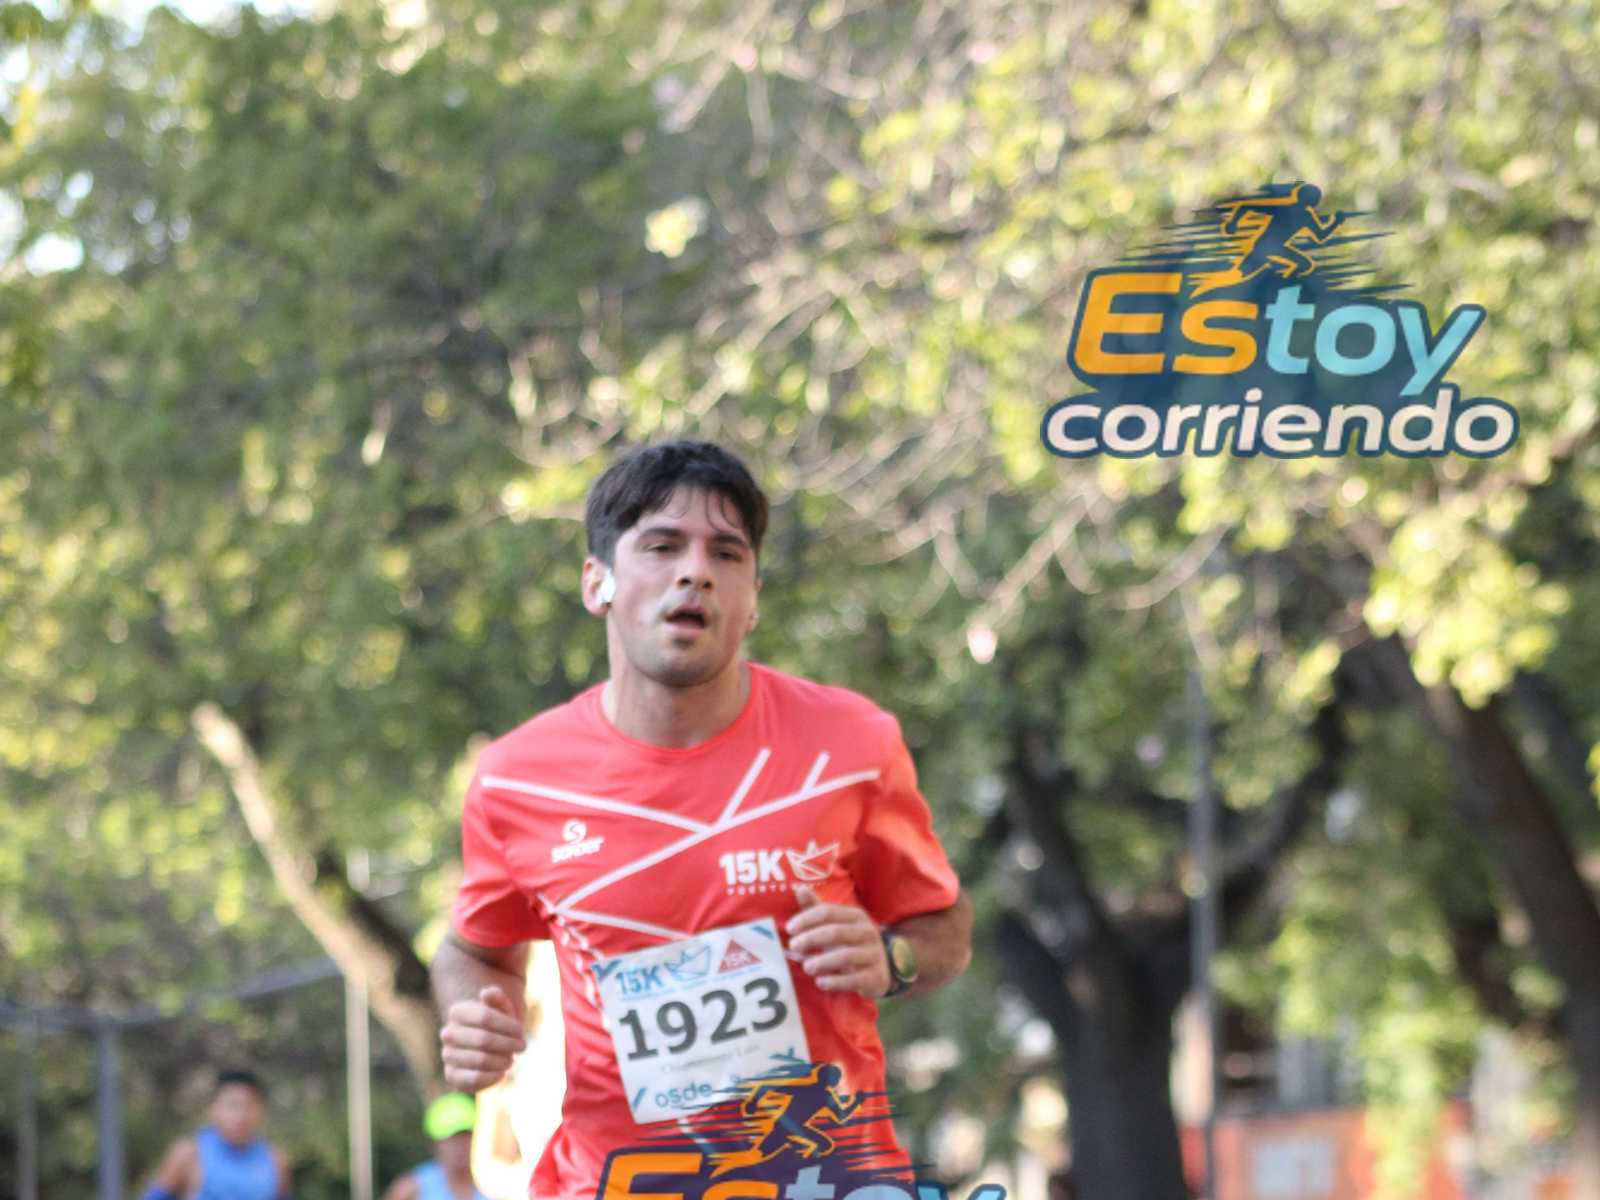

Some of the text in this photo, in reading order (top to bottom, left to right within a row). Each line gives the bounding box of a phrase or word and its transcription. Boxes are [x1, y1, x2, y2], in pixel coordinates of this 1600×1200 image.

[719, 849, 787, 884] 15K
[615, 965, 664, 994] 15K
[619, 977, 788, 1061] 1923
[654, 1082, 713, 1108] osde
